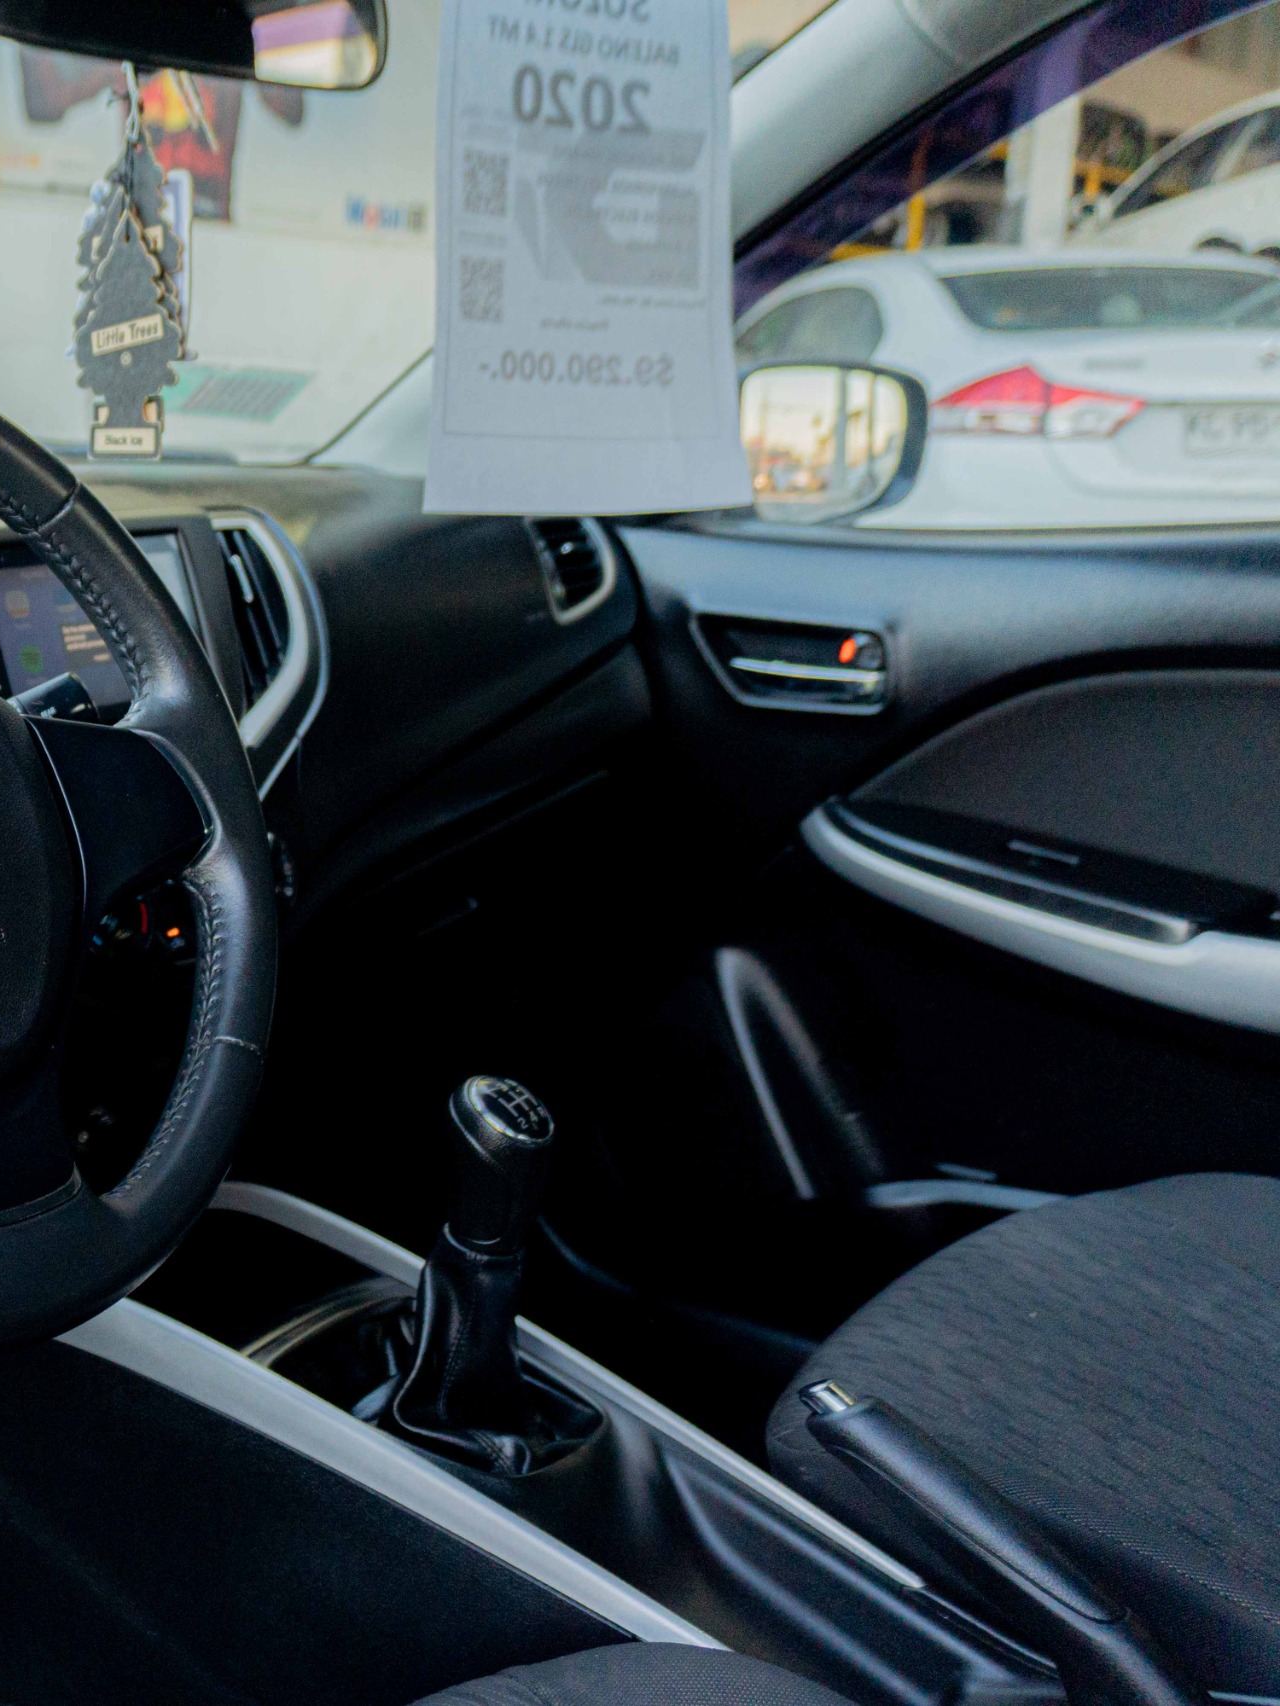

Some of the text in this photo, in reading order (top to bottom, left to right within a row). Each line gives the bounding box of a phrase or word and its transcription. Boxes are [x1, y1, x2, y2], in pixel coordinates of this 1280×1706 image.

[96, 321, 158, 349] Little Trees
[104, 434, 128, 446] Black
[517, 1117, 529, 1130] 2
